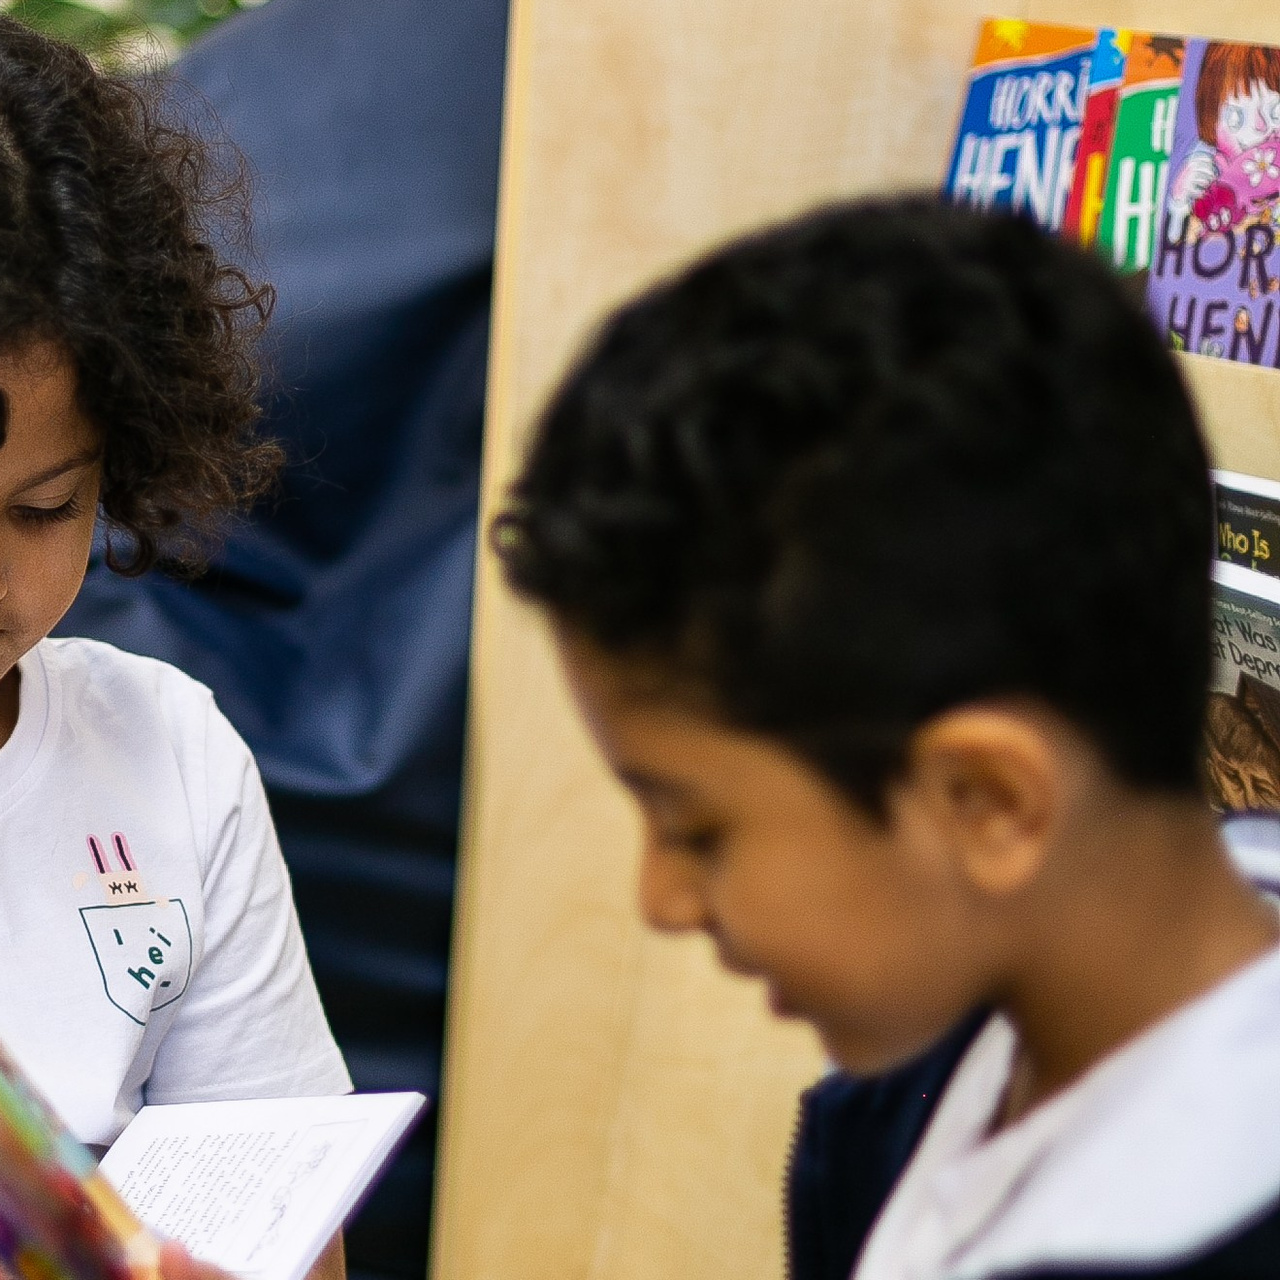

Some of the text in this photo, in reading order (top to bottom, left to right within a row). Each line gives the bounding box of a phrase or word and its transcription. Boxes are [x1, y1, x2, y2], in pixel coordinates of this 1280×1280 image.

[1156, 210, 1278, 294] HOR
[1169, 295, 1280, 365] HEN
[1251, 528, 1271, 560] Is
[1234, 619, 1278, 654] Was
